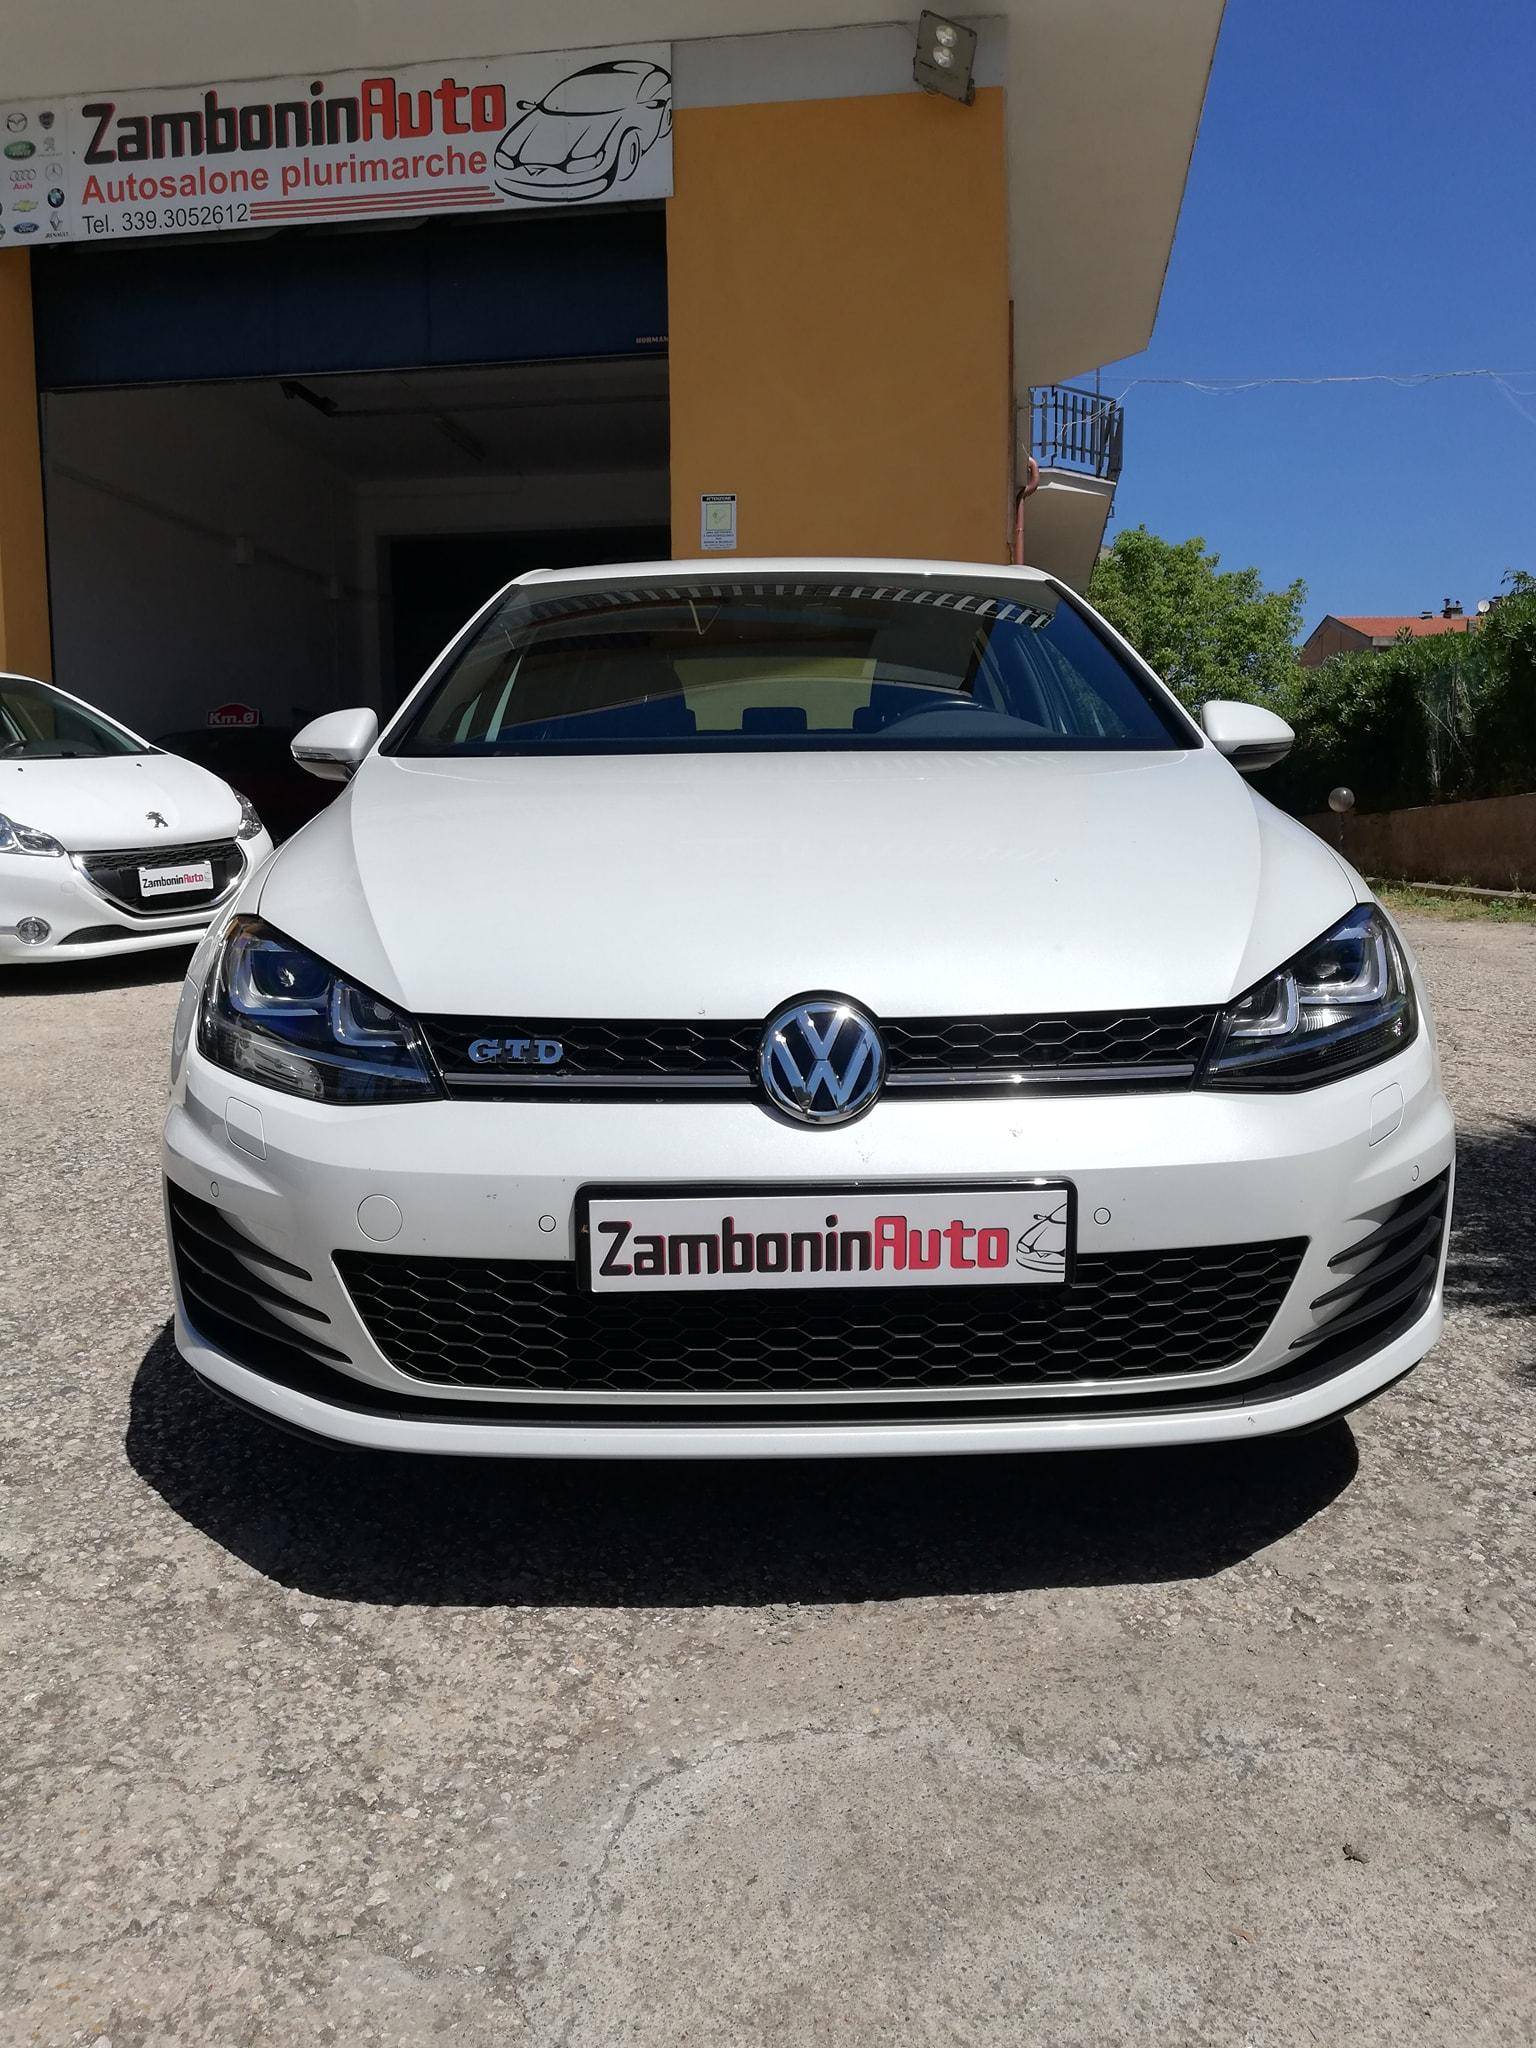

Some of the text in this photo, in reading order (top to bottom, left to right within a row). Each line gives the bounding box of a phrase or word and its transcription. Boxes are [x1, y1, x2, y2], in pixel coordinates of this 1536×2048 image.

[82, 77, 507, 165] ZamboninAuto
[81, 145, 487, 205] Autosalone plurimarche
[82, 203, 248, 236] Tel. 339.3052612
[142, 874, 204, 888] ZamboninAuto
[468, 1038, 564, 1065] GTD
[598, 1214, 1009, 1277] ZamboninAuto
